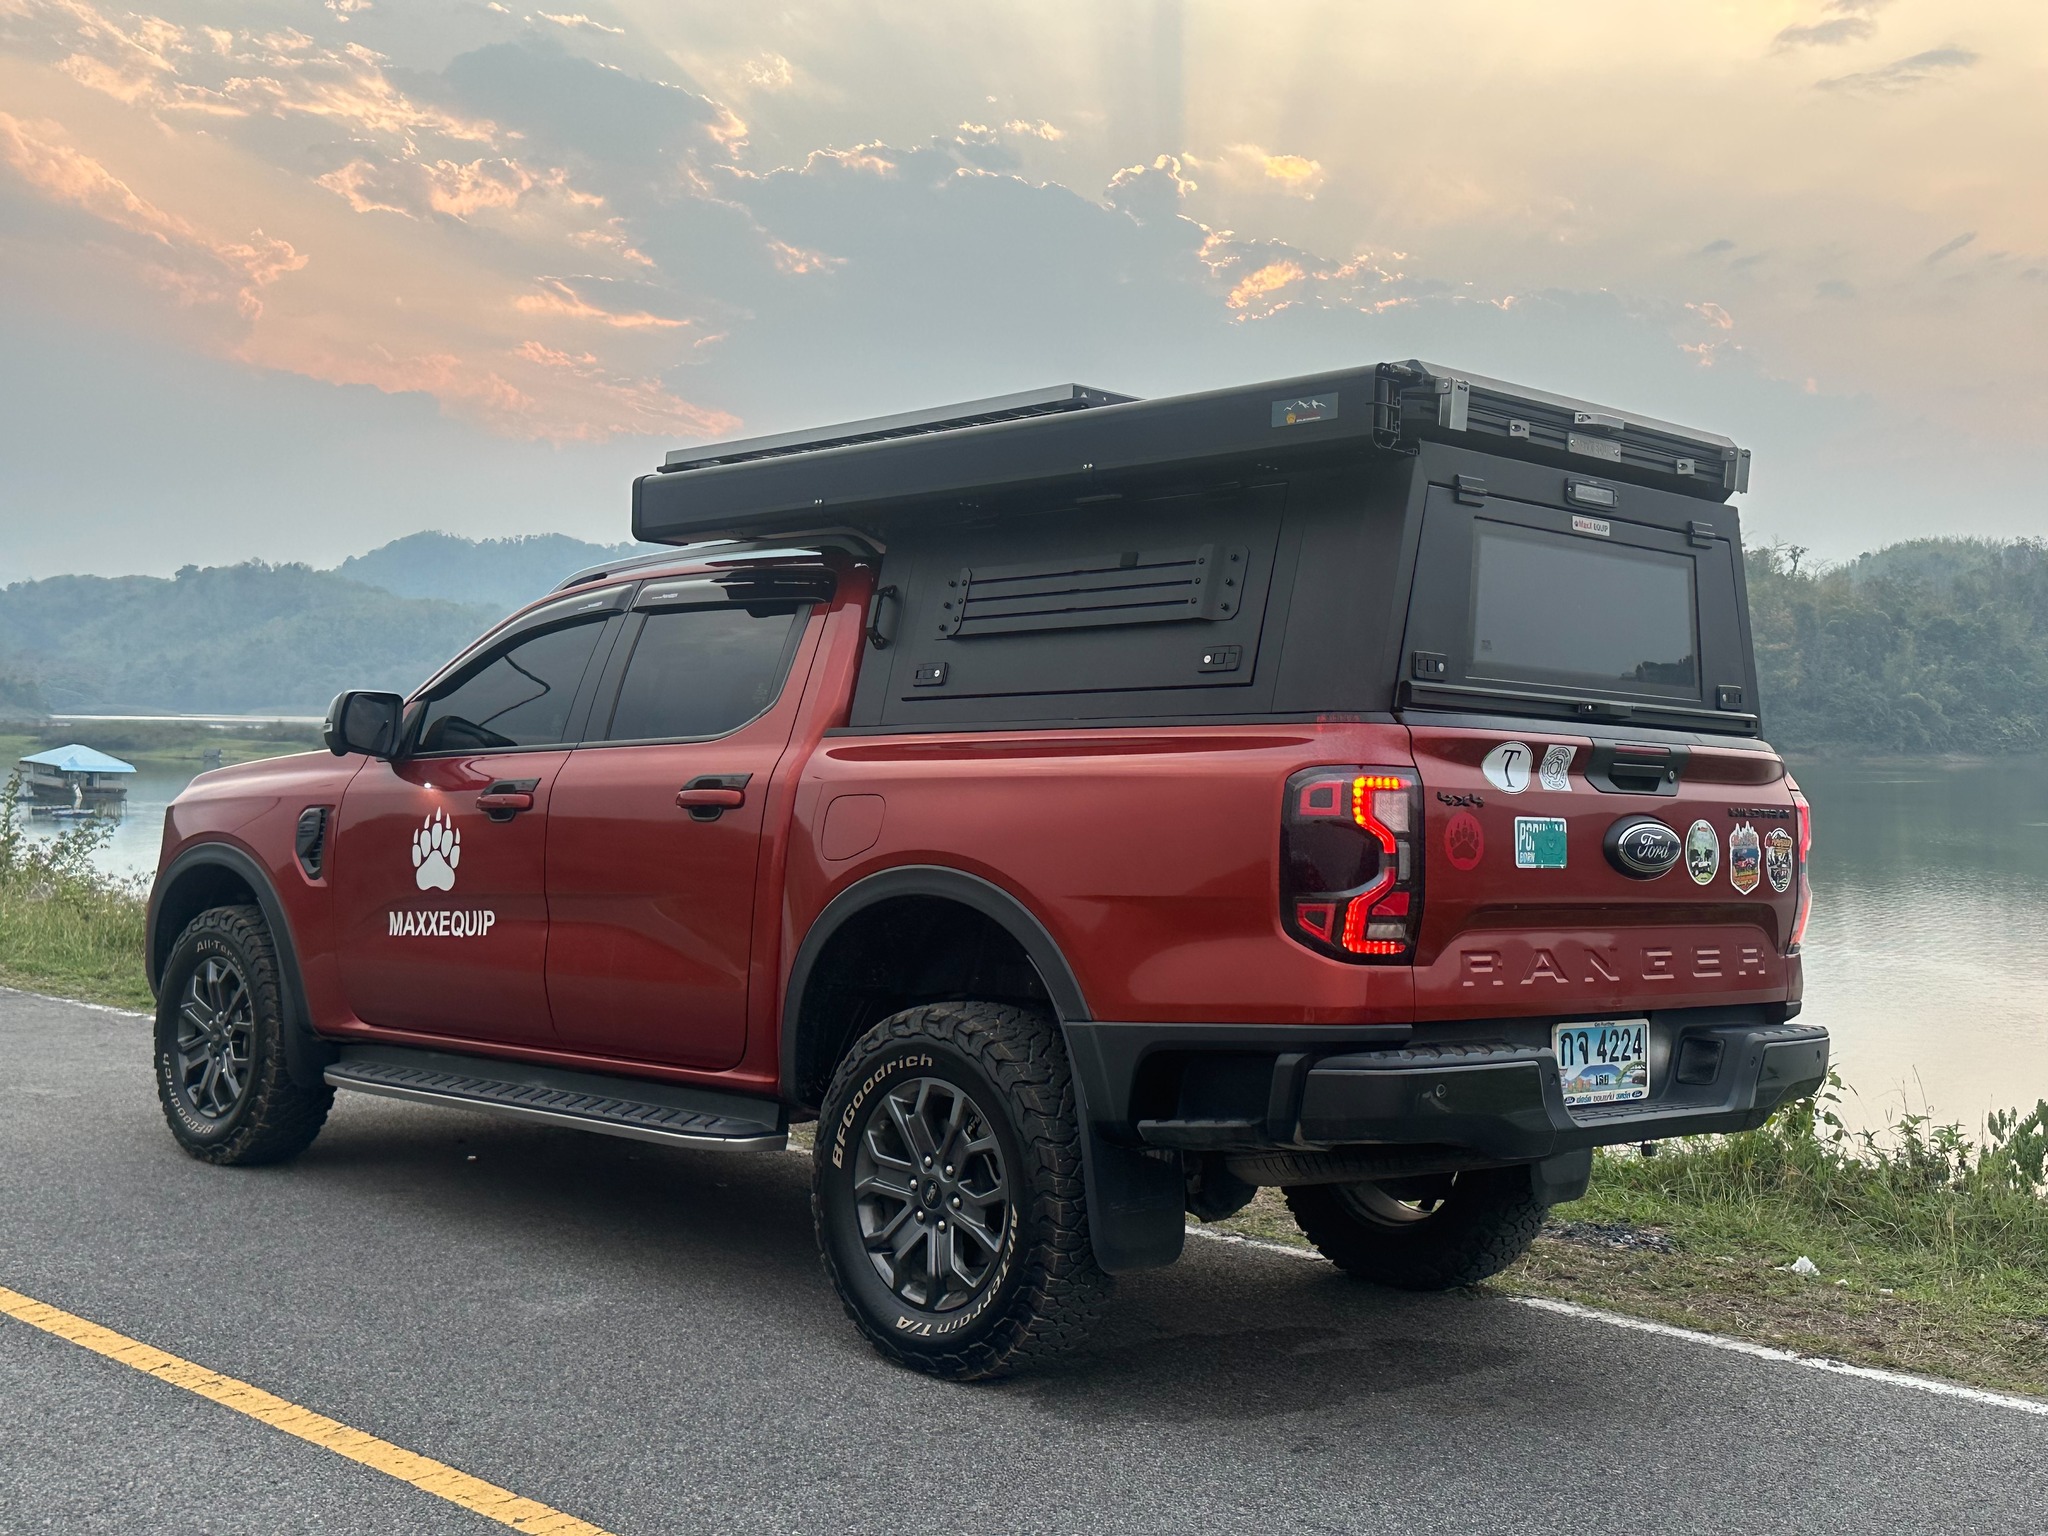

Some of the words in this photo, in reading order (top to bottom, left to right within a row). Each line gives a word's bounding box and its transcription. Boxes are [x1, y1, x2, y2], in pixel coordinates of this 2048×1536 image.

[1501, 749, 1521, 787] T
[1637, 833, 1671, 859] Ford
[388, 910, 496, 938] MAXXEQUIP
[1459, 944, 1767, 987] RANGER
[1560, 1031, 1589, 1067] กจ
[1596, 1028, 1643, 1064] 4224
[162, 1052, 215, 1135] BFGoodrich
[832, 1053, 934, 1170] BFGoodrich
[896, 1315, 932, 1337] T/A
